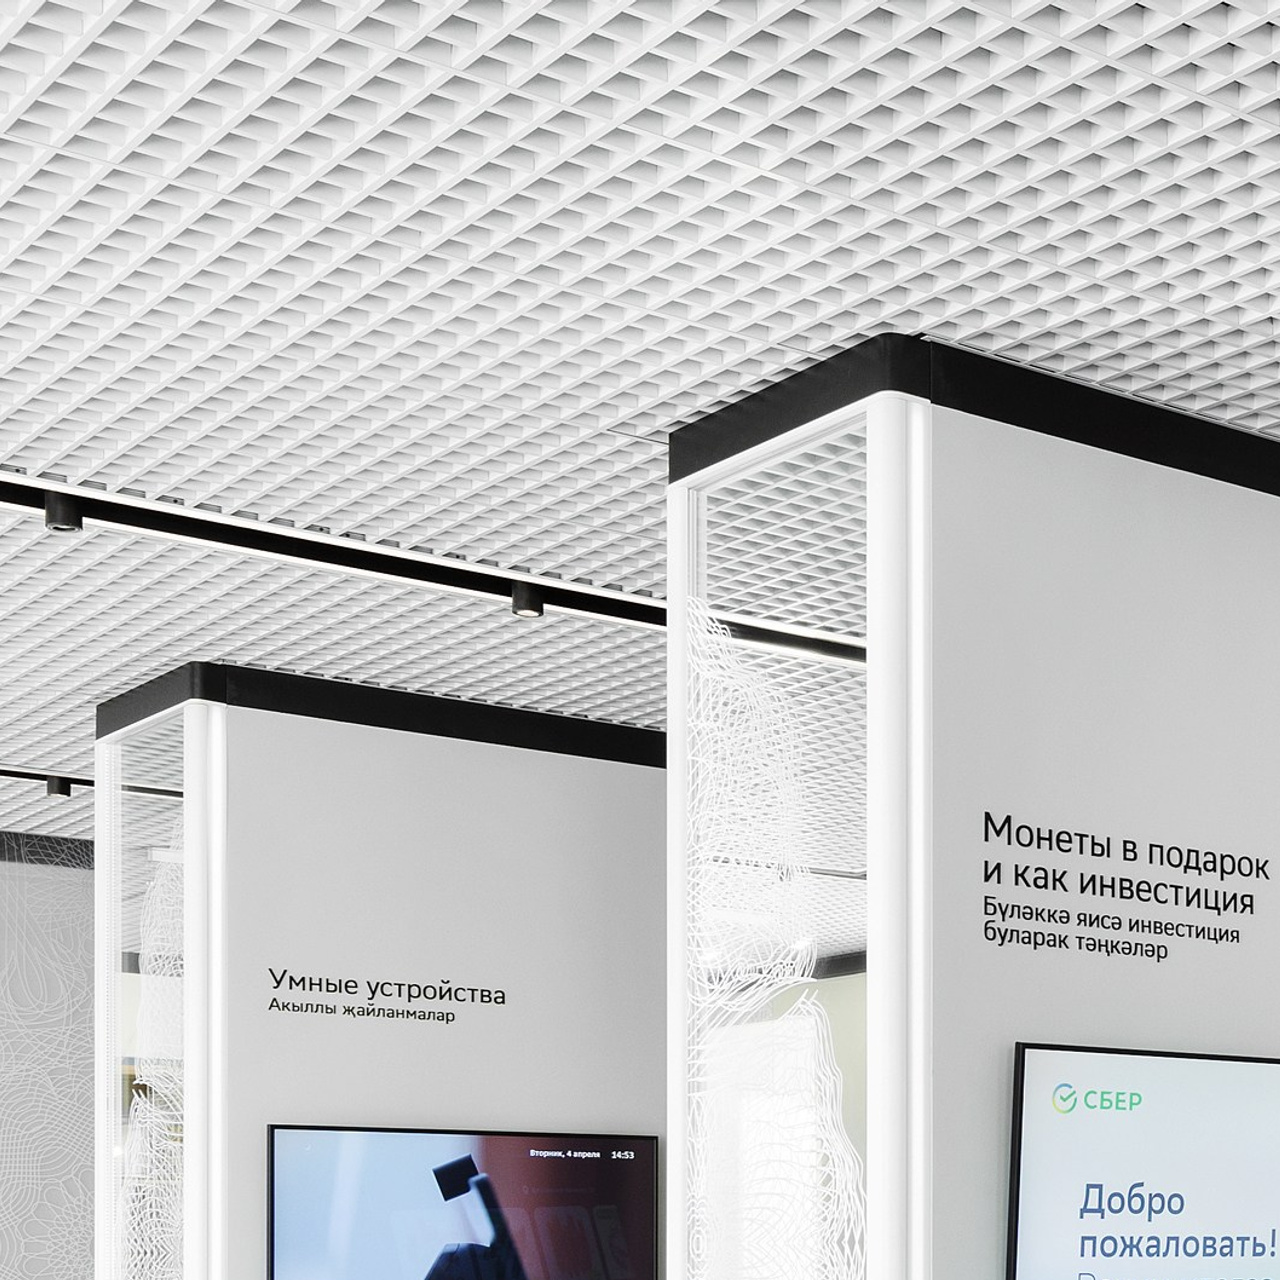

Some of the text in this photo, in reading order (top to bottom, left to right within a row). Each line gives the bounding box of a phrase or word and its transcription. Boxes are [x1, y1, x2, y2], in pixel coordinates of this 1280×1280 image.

[984, 811, 1270, 881] Монеты в подарок
[984, 861, 1254, 915] и как инвестиция
[984, 896, 1240, 944] Бүләккә яисә инвестиция
[984, 920, 1168, 962] буларак тәңкәләр
[269, 968, 506, 1005] Умные устройства
[268, 998, 455, 1024] Акыллы җайланмалар
[1083, 1091, 1142, 1112] СБЕР
[530, 1149, 565, 1158] Вторник,
[612, 1151, 634, 1159] 14:53
[1079, 1182, 1185, 1221] Добро
[1079, 1229, 1277, 1258] пожаловать!
